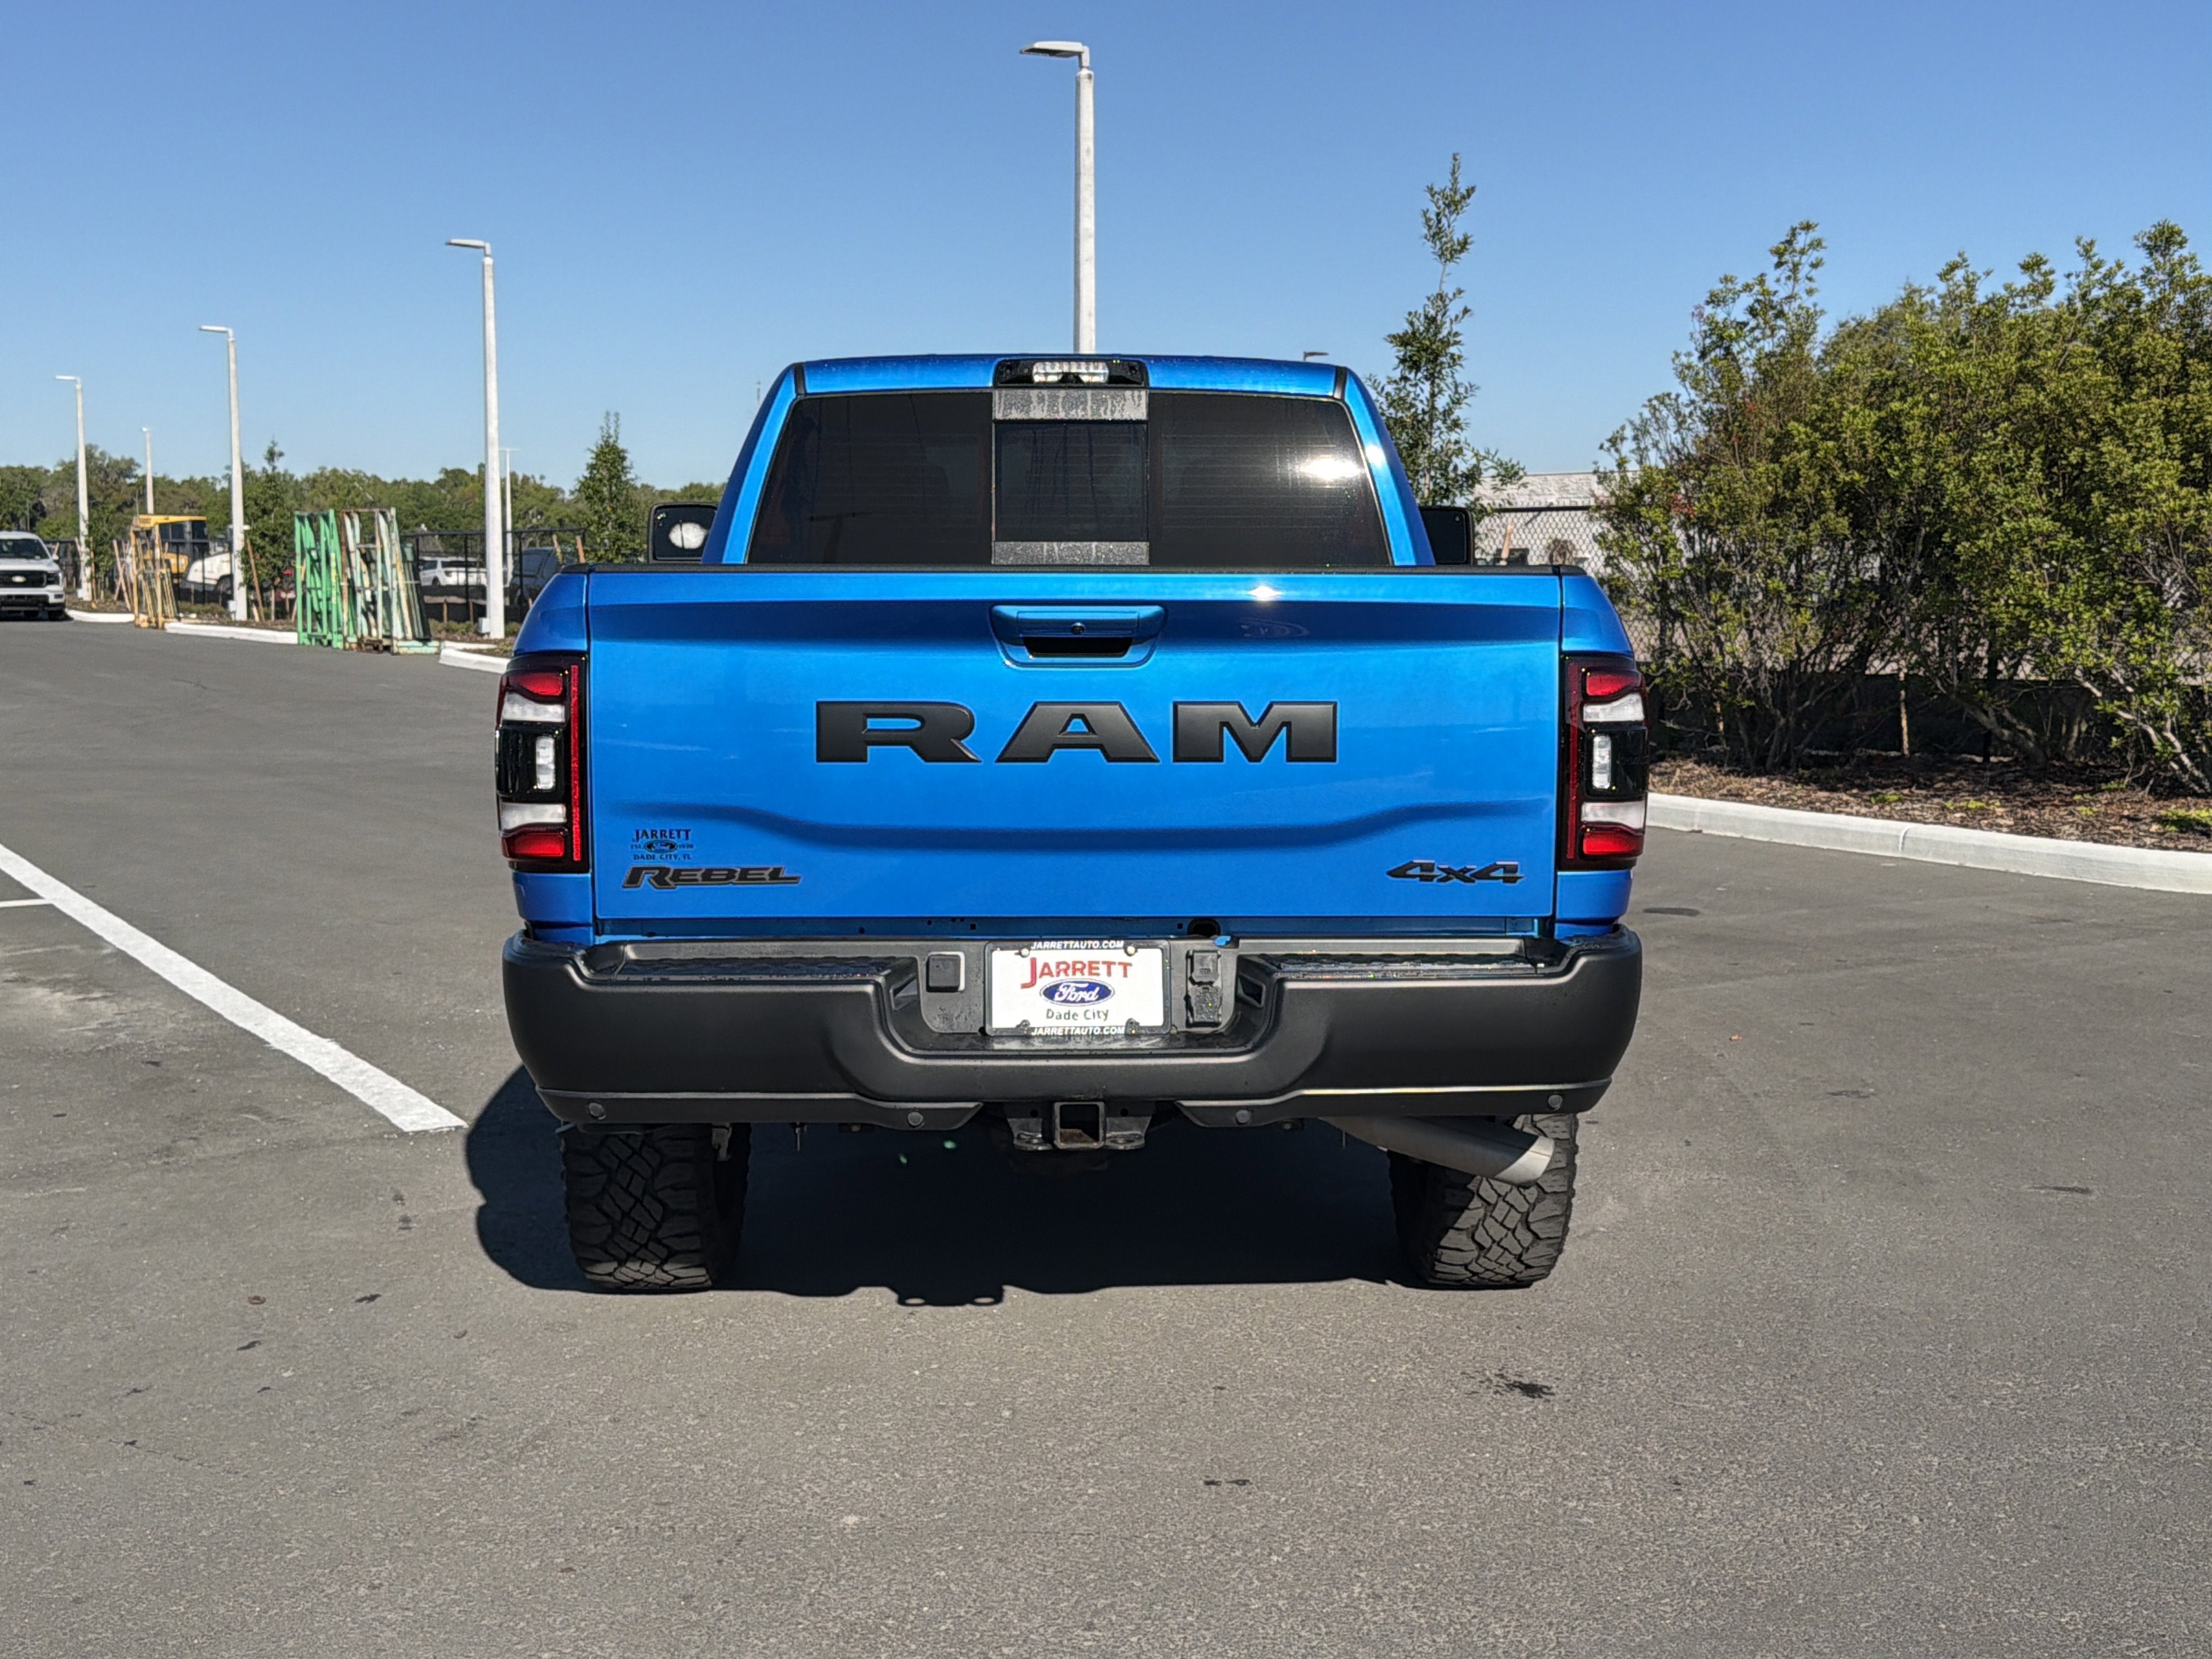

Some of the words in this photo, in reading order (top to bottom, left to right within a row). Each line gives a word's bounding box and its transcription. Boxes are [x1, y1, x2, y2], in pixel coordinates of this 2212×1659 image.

[816, 701, 1338, 763] RAM
[631, 828, 691, 842] JARRETT
[622, 865, 802, 889] REBEL
[1386, 860, 1524, 883] 4x4
[1031, 940, 1124, 949] JARRETTAUTO.COM
[1020, 957, 1132, 989] JARRETT
[1054, 982, 1099, 1002] Ford
[1046, 1008, 1079, 1020] Dade
[1084, 1009, 1109, 1021] City
[1031, 1026, 1125, 1036] JARRETTAUTO.COM
